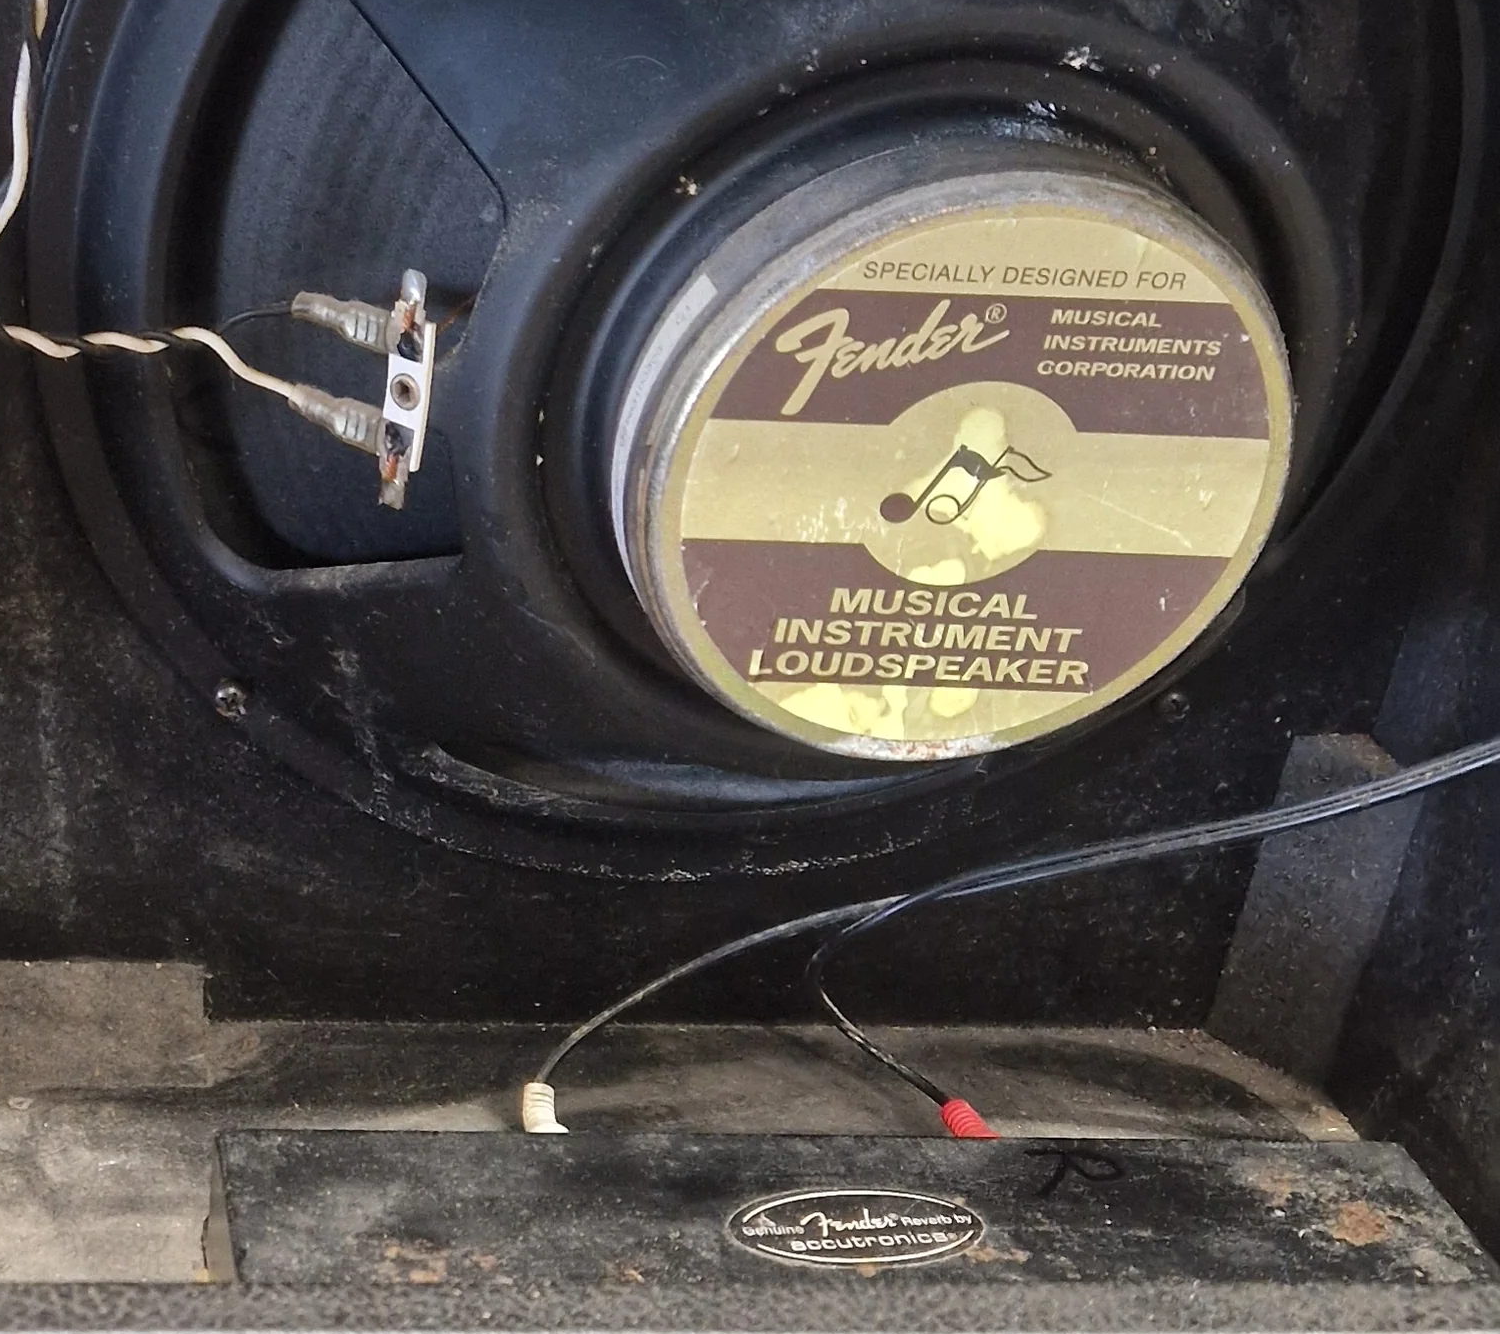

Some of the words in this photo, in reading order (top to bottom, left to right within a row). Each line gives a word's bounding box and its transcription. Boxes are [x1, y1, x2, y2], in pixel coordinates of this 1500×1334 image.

[862, 259, 996, 284] SPECIALLY
[1001, 265, 1130, 289] DESIGNED
[1136, 269, 1187, 291] FOR
[1050, 308, 1162, 328] MUSICAL
[1043, 333, 1222, 357] INSTRUMENTS
[1036, 359, 1216, 382] CORPORATION
[829, 586, 1039, 619] MUSICAL
[774, 618, 1083, 653] INSTRUMENT
[748, 649, 1090, 686] LOUDSPEAKER
[741, 1224, 806, 1238] Genuine
[900, 1215, 953, 1228] Reverb
[953, 1213, 973, 1226] by
